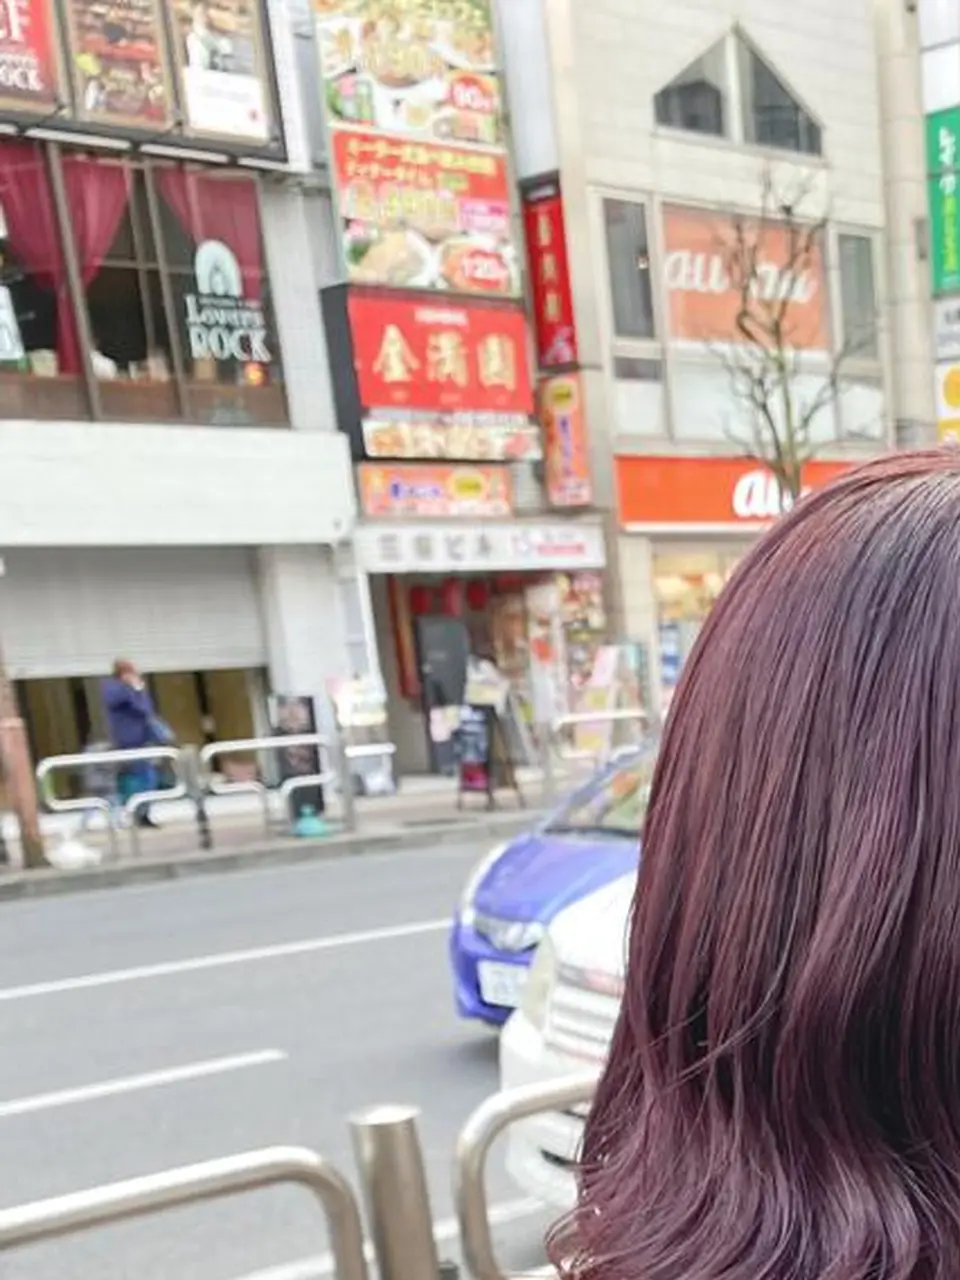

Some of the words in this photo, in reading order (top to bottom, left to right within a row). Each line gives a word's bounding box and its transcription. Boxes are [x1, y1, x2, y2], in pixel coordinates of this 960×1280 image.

[663, 248, 730, 294] au
[185, 294, 265, 329] Lovers
[188, 325, 272, 363] ROCK
